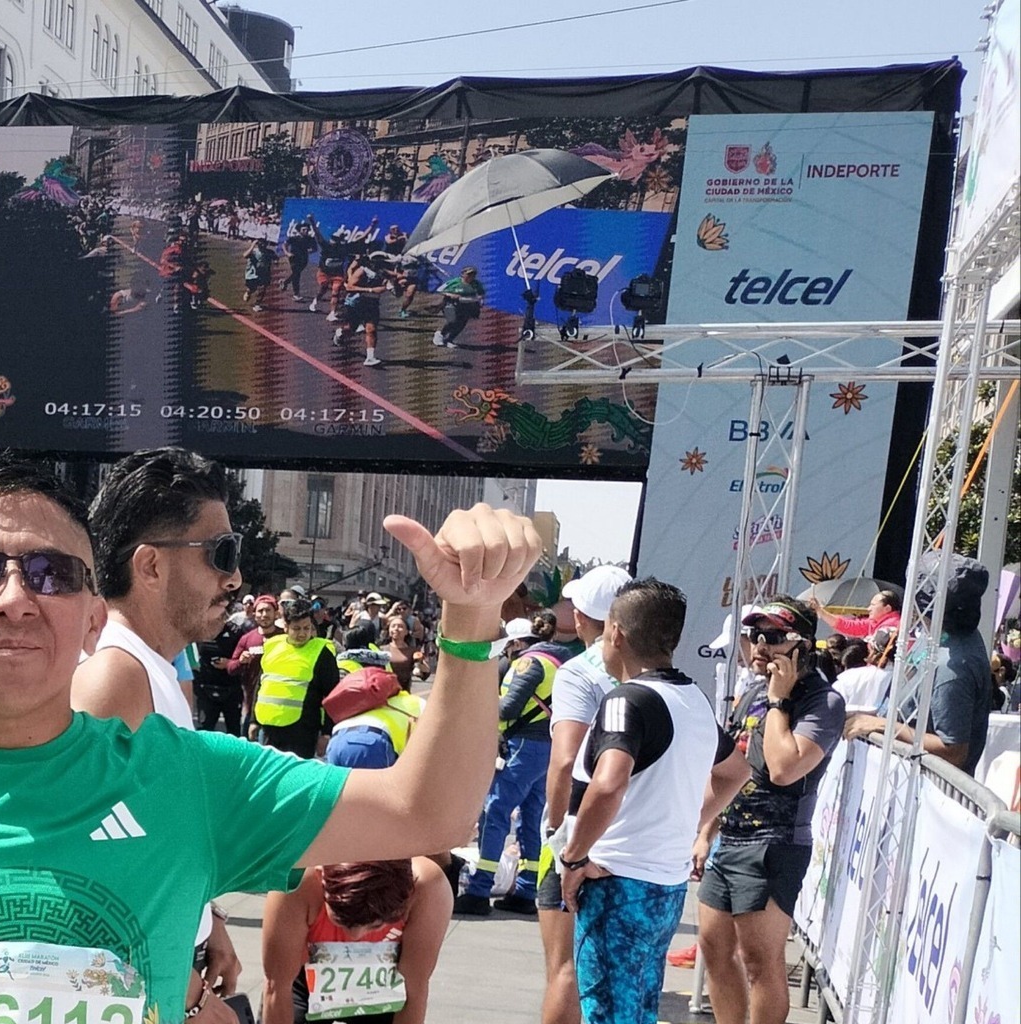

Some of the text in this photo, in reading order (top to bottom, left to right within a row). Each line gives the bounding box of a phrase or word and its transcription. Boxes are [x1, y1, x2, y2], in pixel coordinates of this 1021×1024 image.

[806, 164, 900, 178] INDEPORTE
[706, 178, 794, 186] GOBIERNO DE LA
[757, 186, 793, 195] MÉXICO
[724, 268, 854, 306] telcel
[44, 402, 385, 422] 04:17:15 04:20:50 04:17:15
[906, 846, 958, 1017] telcel
